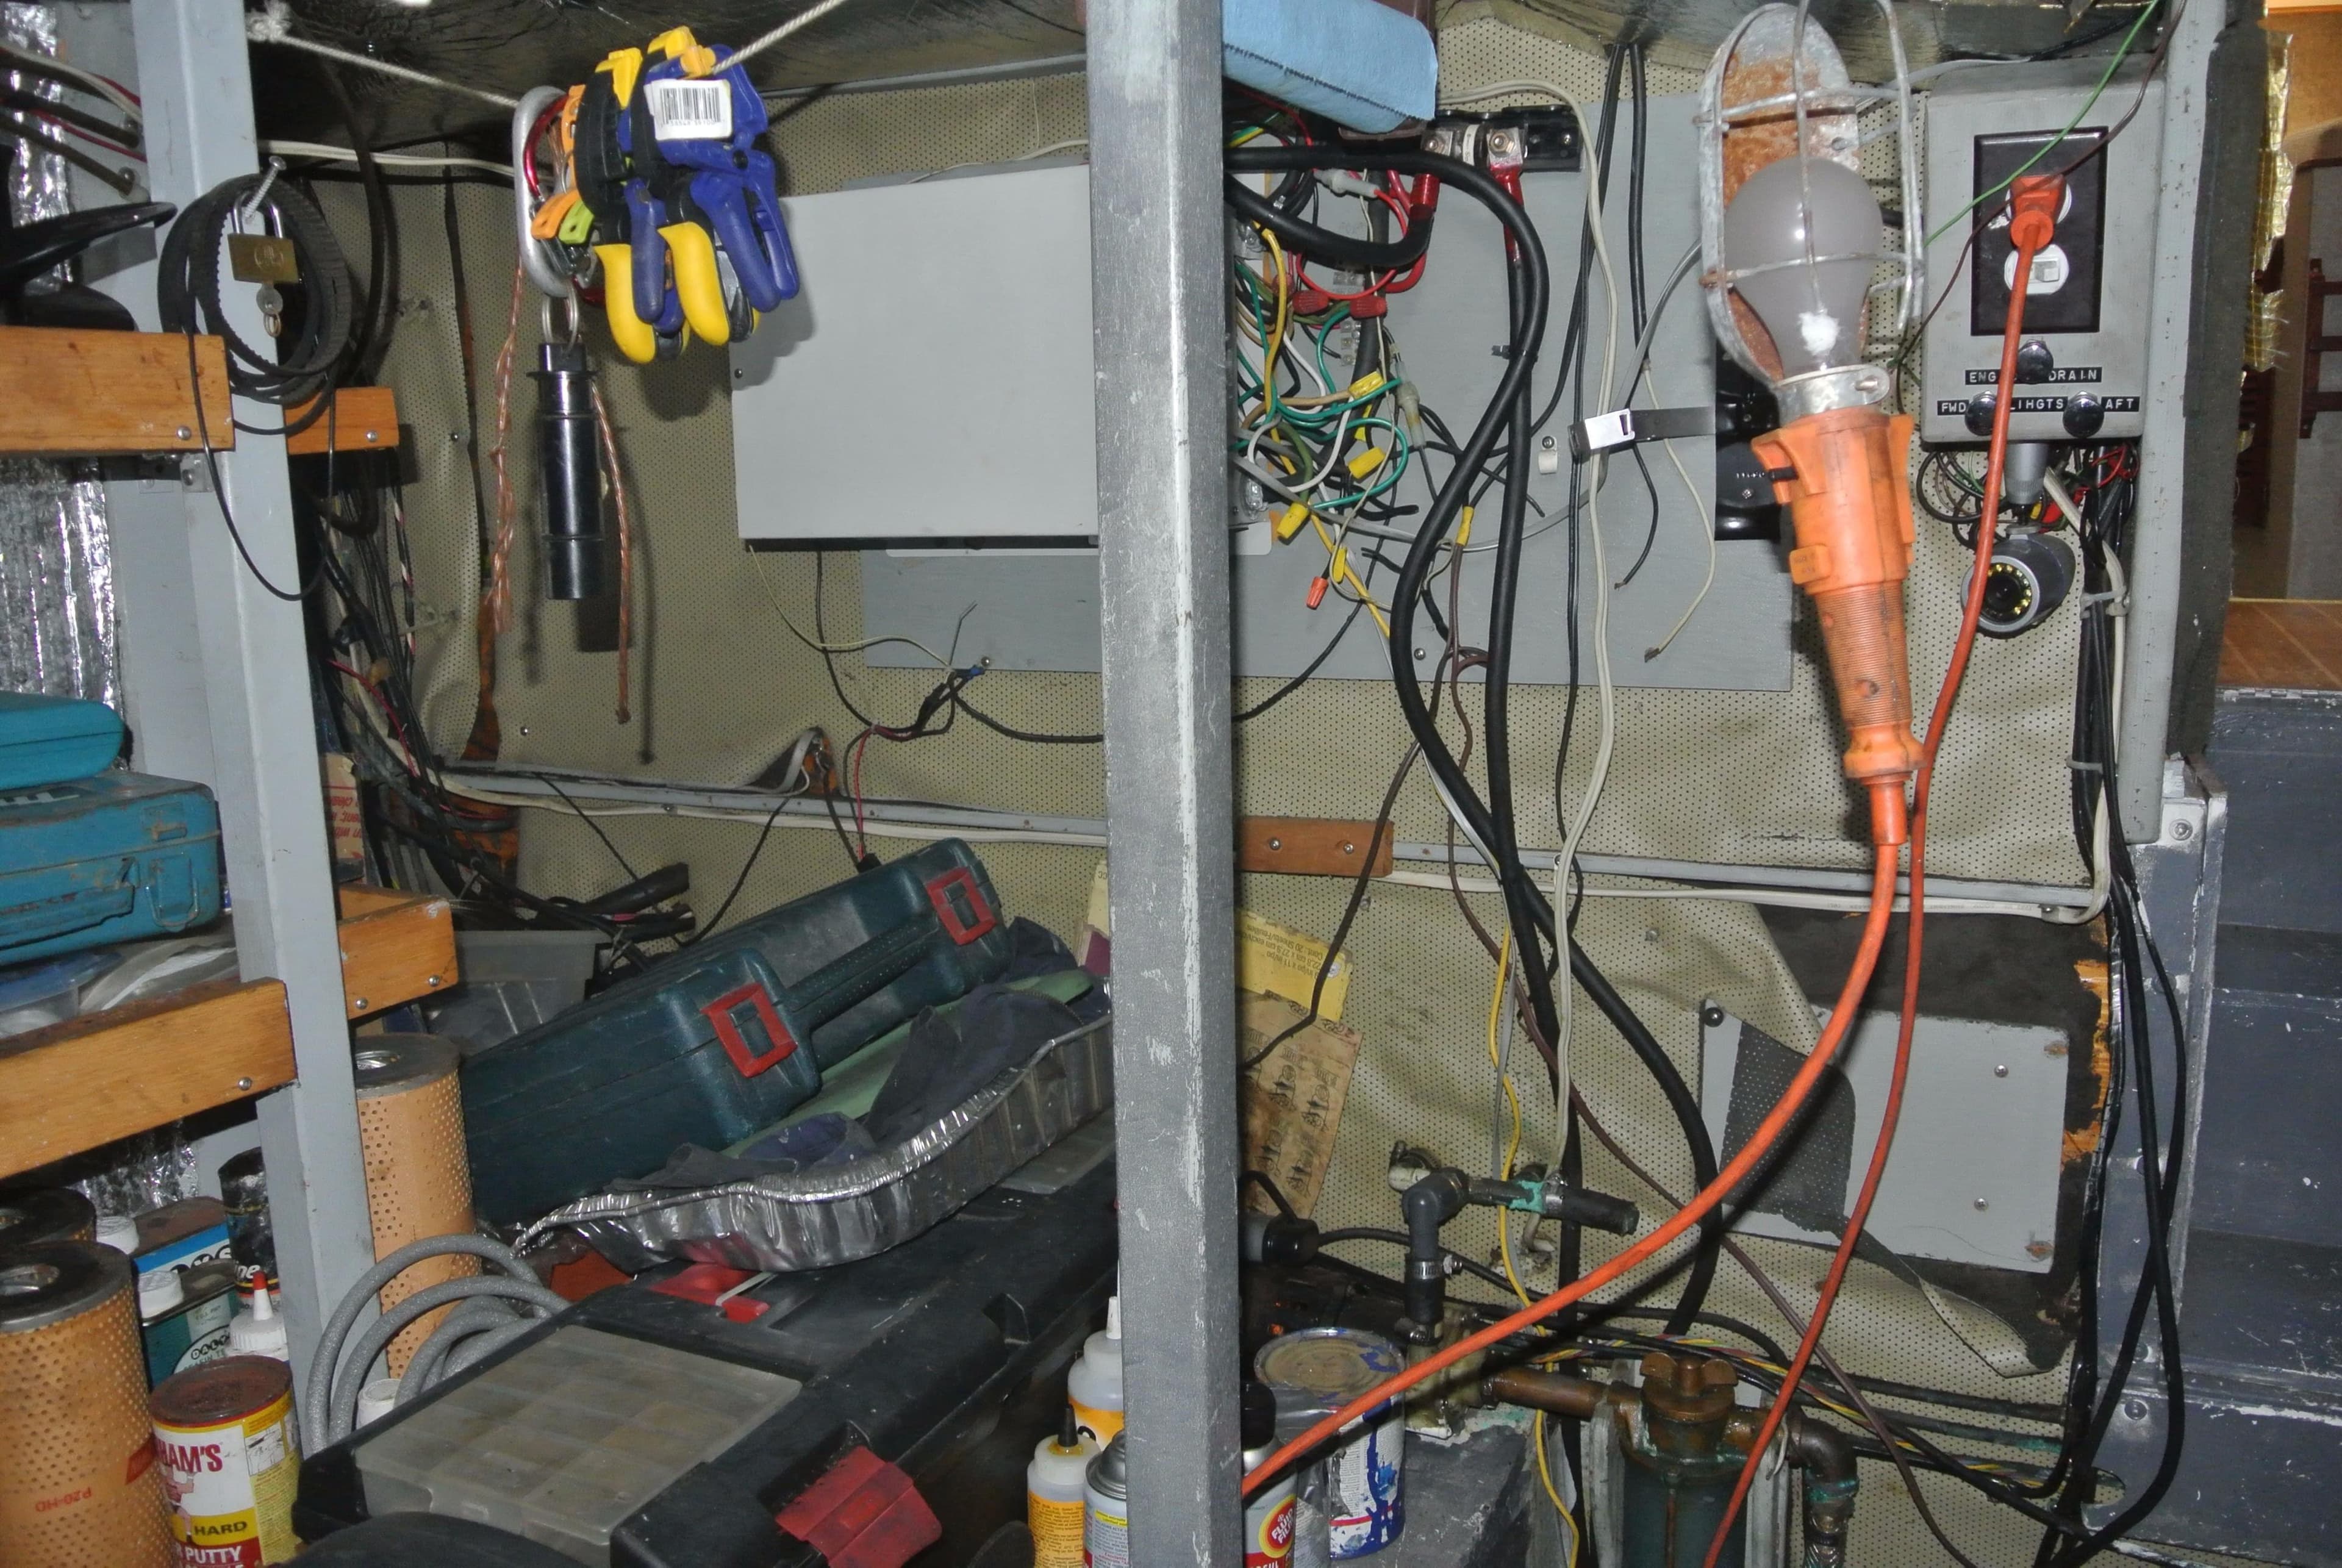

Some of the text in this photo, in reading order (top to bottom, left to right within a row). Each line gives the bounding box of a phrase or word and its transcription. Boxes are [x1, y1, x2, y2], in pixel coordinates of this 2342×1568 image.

[2049, 370, 2097, 382] DRAIN
[1941, 403, 1966, 413] FWD
[2105, 398, 2134, 409] AFT
[1295, 944, 1303, 953] 20
[157, 1438, 223, 1473] HAM'S
[194, 1520, 248, 1536] HARD
[185, 1545, 242, 1564] PUTTY
